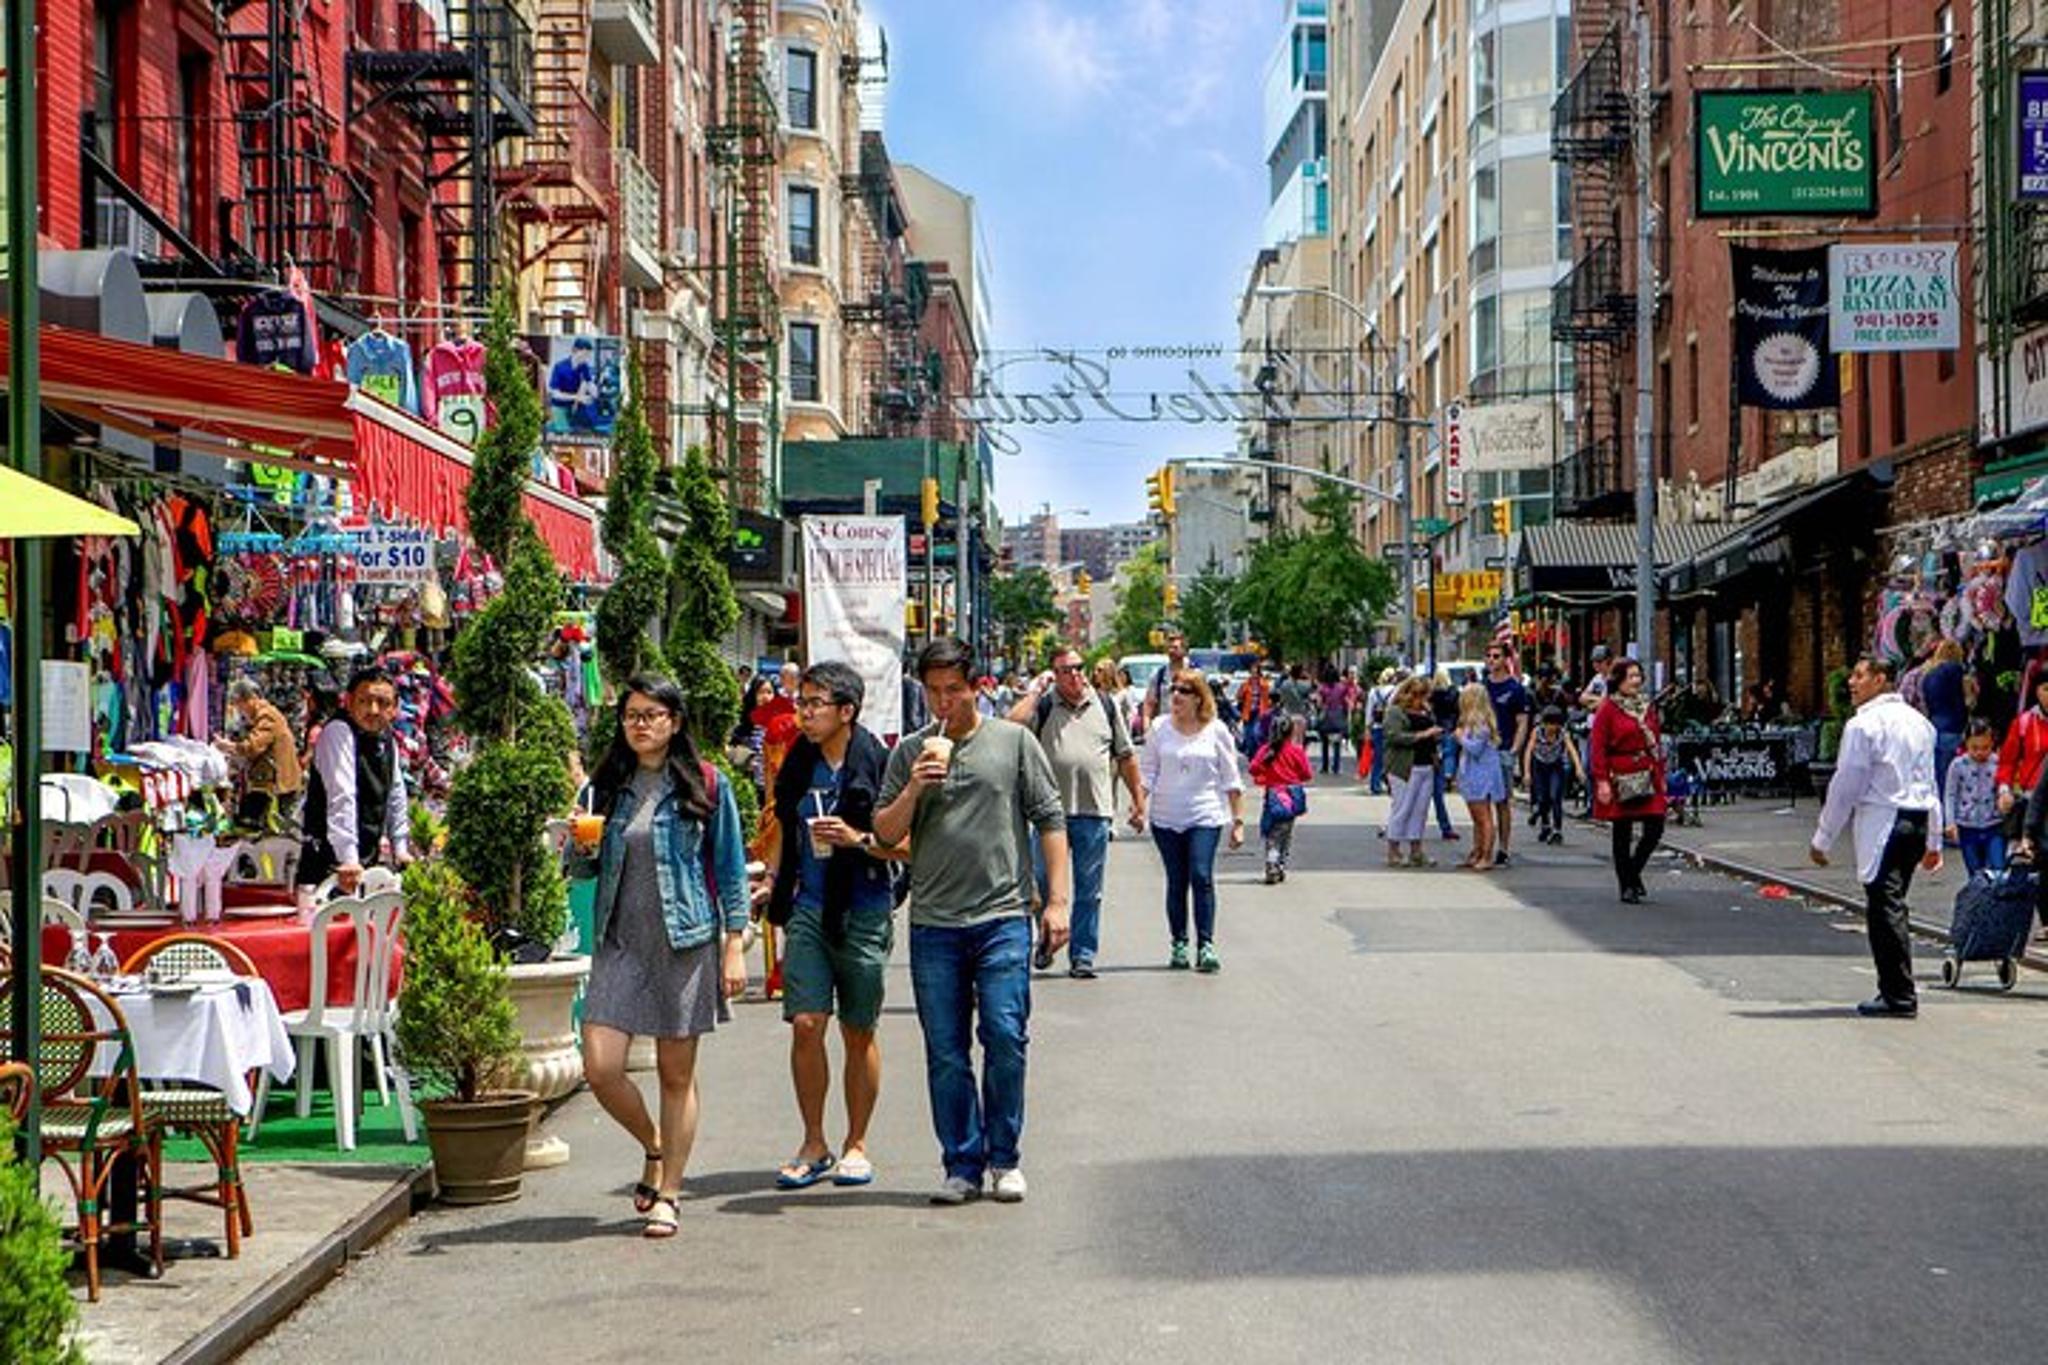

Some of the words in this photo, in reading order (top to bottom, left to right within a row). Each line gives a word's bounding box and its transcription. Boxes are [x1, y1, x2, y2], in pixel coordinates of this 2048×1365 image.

[1740, 104, 1778, 131] The
[1780, 104, 1857, 140] Original
[1845, 275, 1916, 293] PIZZA
[1926, 274, 1947, 294] &
[1842, 293, 1948, 311] RESTAURANT
[1854, 329, 1882, 341] FREE
[832, 520, 893, 540] Course
[387, 545, 425, 567] $10
